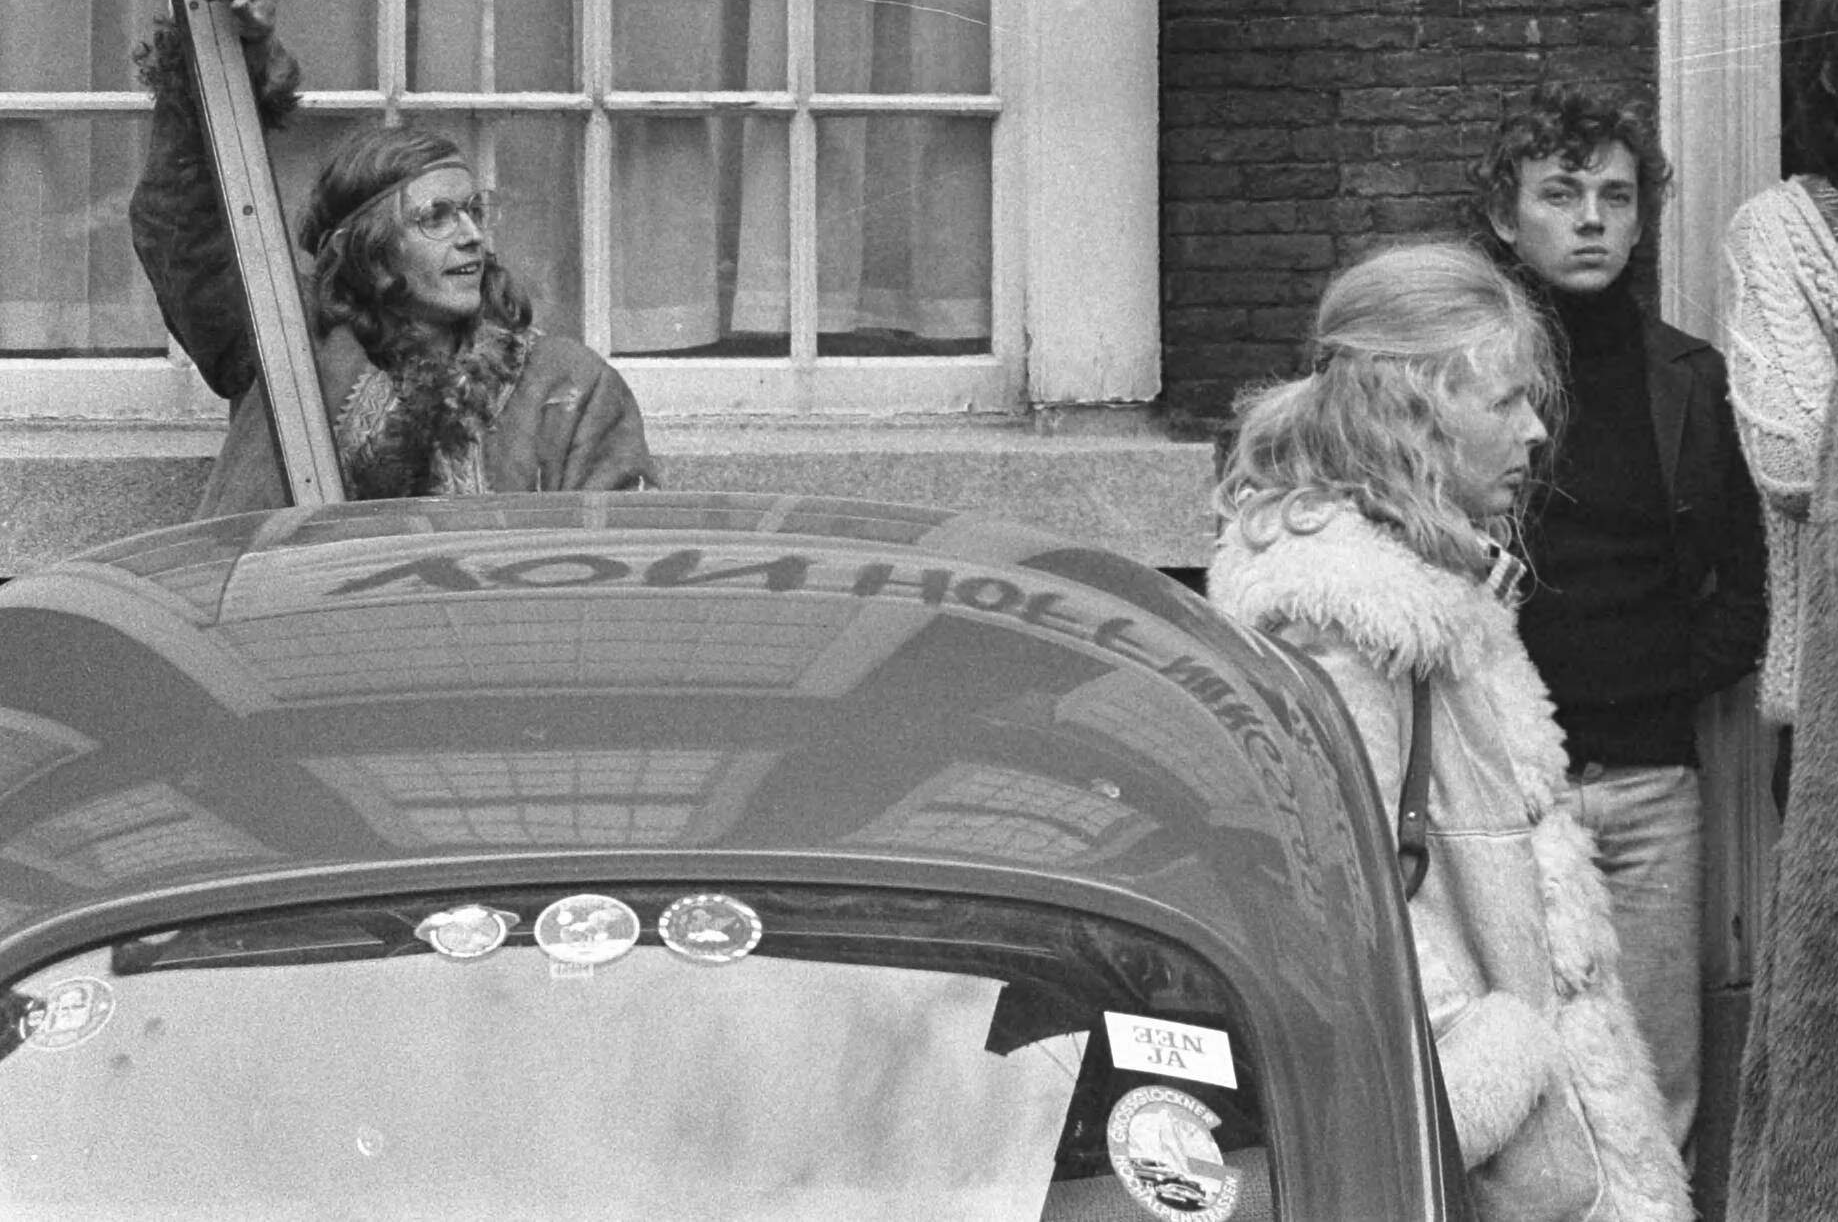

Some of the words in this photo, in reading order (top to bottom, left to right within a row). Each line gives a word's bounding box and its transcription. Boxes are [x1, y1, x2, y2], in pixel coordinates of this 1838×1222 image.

[1133, 1026, 1206, 1054] NEE
[1148, 1050, 1187, 1069] JA
[1111, 1088, 1214, 1143] GROSSGLOCKNER
